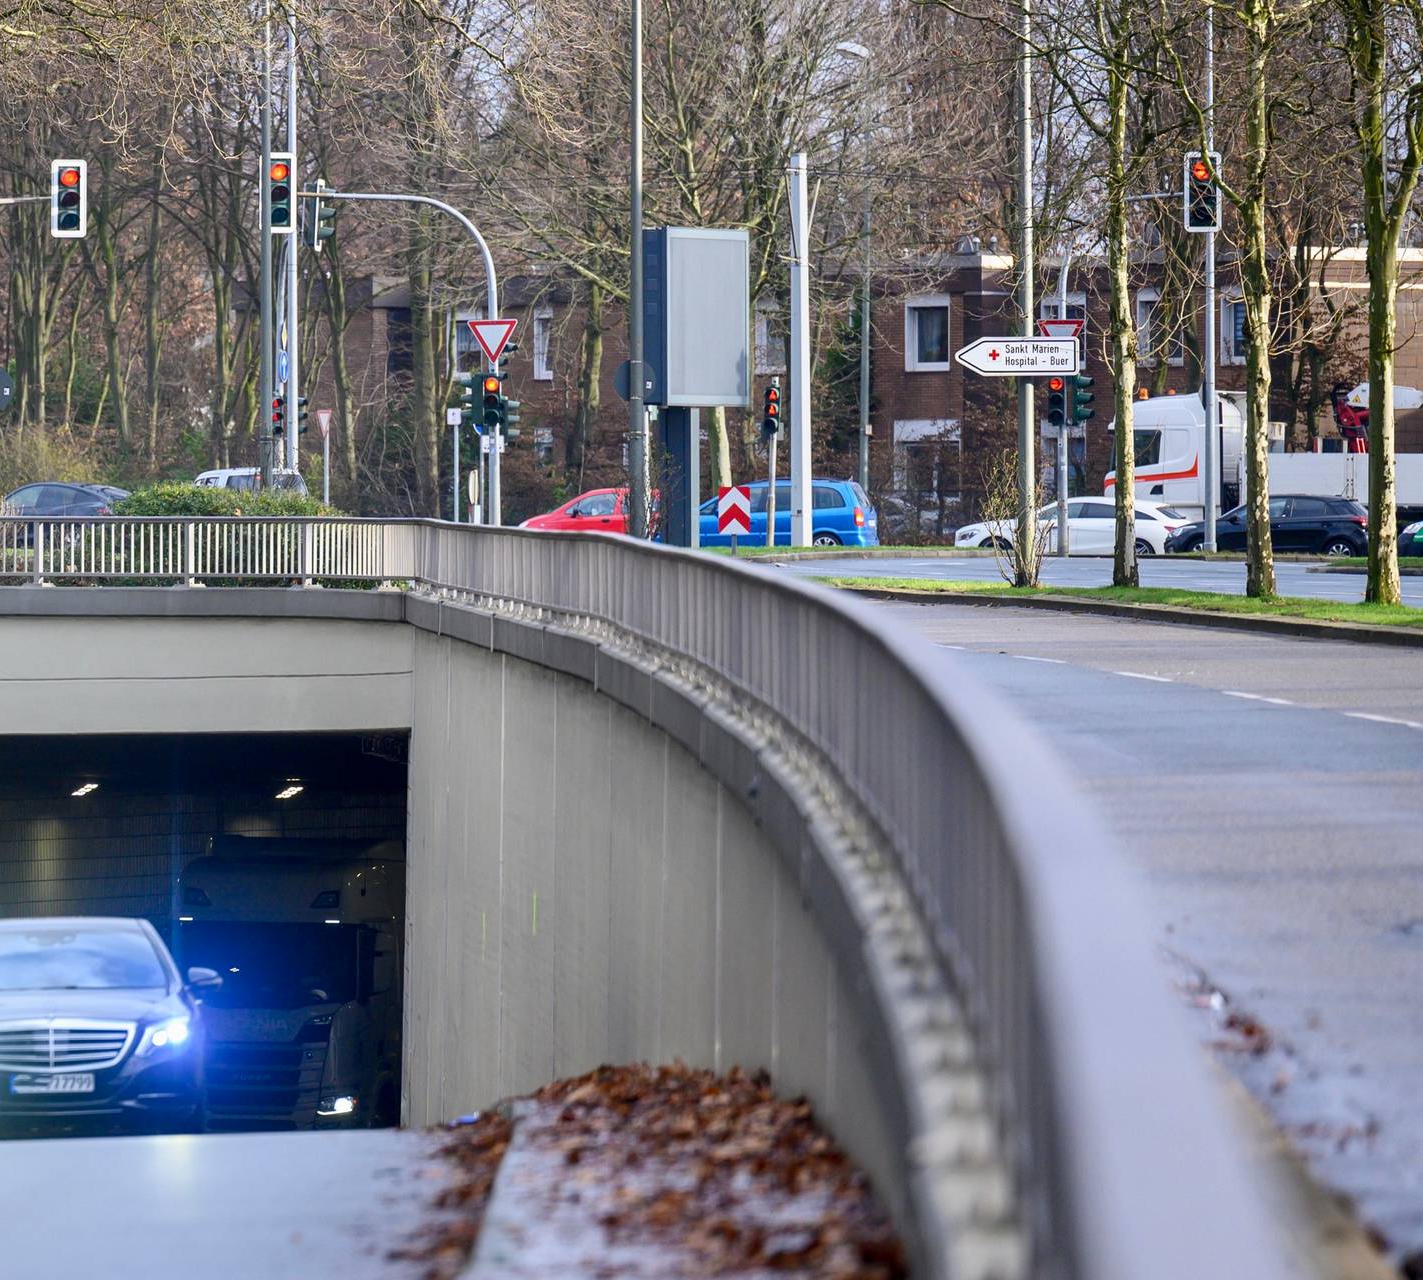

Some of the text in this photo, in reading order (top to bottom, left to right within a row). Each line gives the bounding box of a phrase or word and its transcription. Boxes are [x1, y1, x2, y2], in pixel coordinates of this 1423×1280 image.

[1005, 344, 1059, 353] Sankt Marien
[1005, 356, 1037, 367] Hospital
[1050, 356, 1068, 365] Buer
